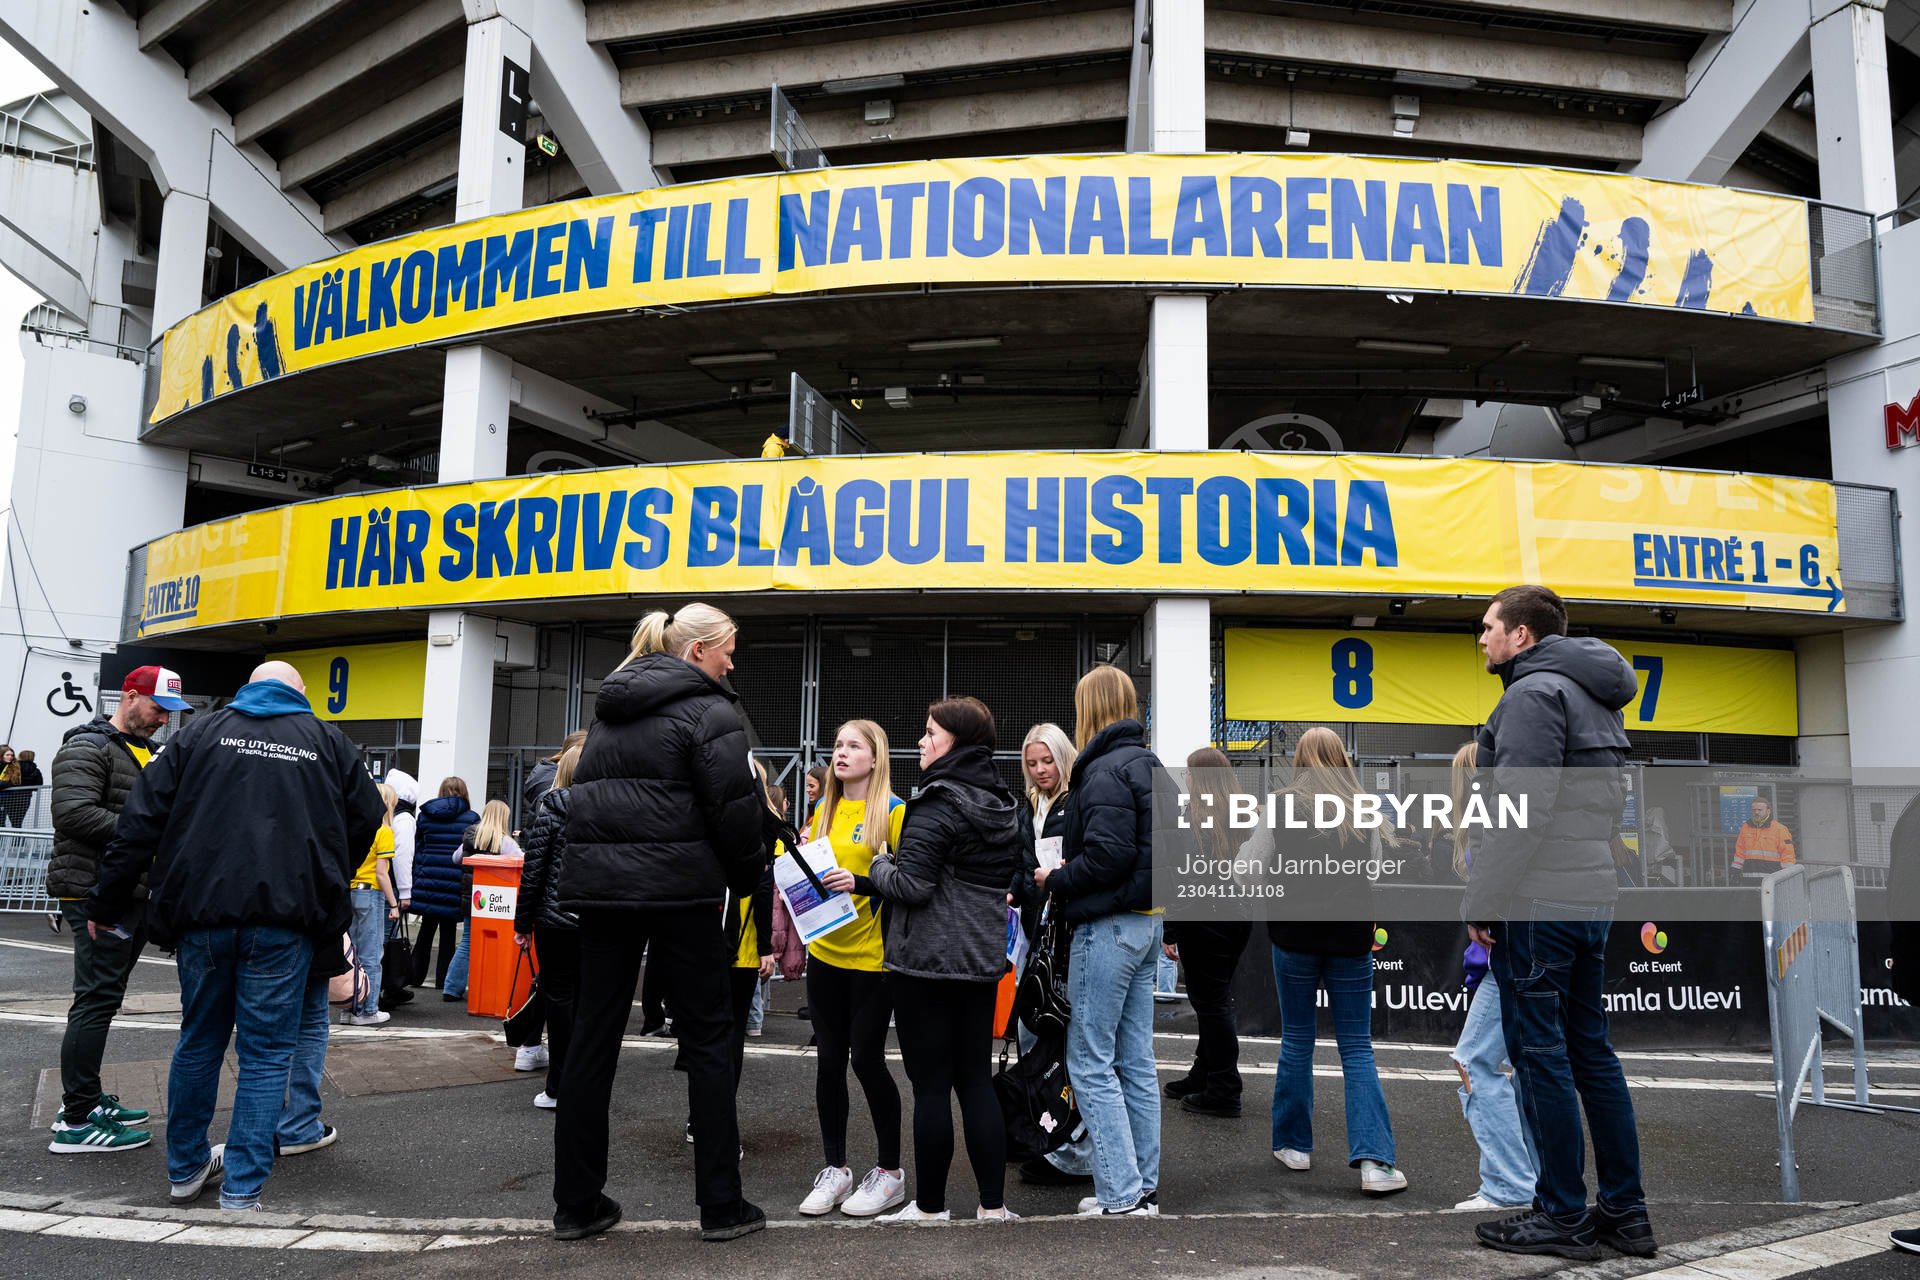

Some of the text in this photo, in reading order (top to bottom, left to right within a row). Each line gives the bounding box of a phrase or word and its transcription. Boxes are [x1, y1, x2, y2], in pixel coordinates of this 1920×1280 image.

[508, 70, 522, 104] L
[511, 122, 516, 132] 1
[294, 176, 1502, 350] VÄLKOMMEN TILL NATIONALARENAN
[326, 475, 1398, 590] HÄR SKRIVS BLÅGUL HISTORIA
[1633, 533, 1745, 581] ENTRÉ
[146, 574, 200, 618] ENTRÉ 10
[327, 657, 349, 715] 9
[1331, 637, 1374, 709] 8
[1633, 655, 1663, 722] 7
[220, 737, 318, 761] UNG UTVECKLING
[237, 748, 299, 762] LYSEKILS KOMMUN
[489, 894, 503, 903] Got
[489, 903, 511, 913] Event
[1629, 961, 1683, 973] Got Event
[1385, 985, 1469, 1012] Ullevi
[1601, 985, 1741, 1012] amla Ullevi
